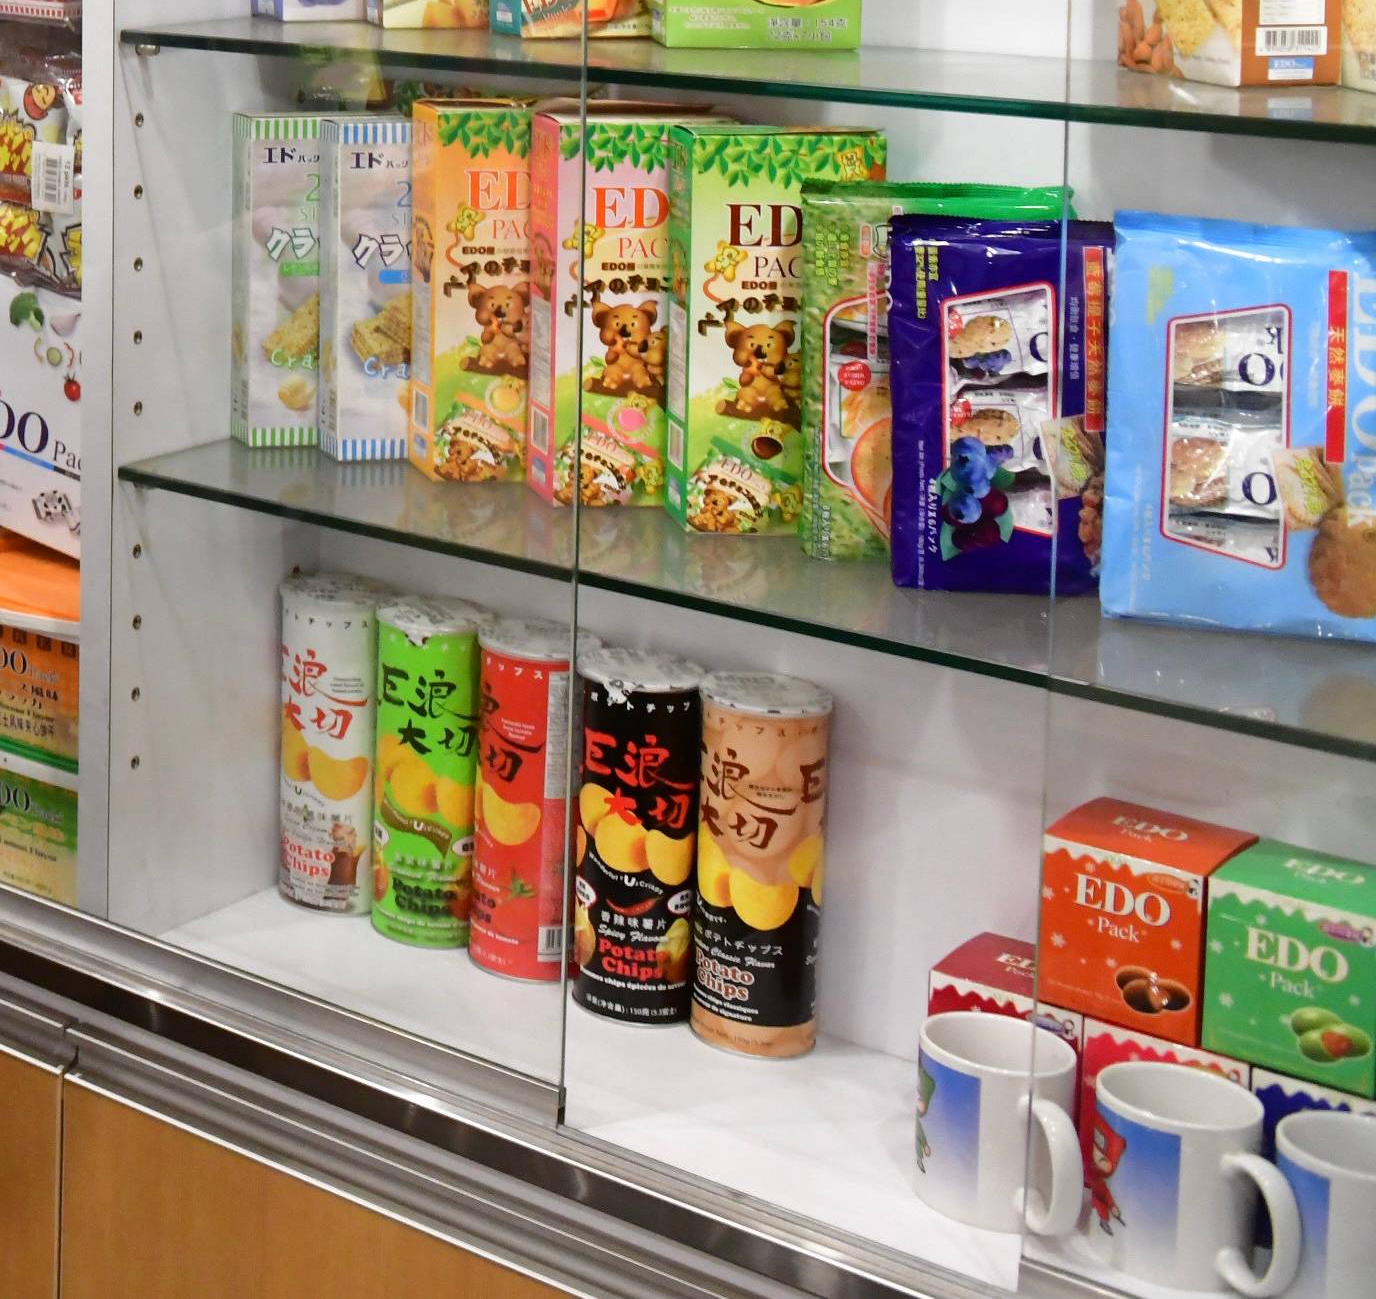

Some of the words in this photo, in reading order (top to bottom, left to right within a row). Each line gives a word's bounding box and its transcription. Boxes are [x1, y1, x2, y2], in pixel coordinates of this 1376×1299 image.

[466, 170, 531, 212] ED
[592, 185, 670, 230] ED
[726, 203, 803, 248] ED
[617, 236, 669, 258] PAC
[363, 357, 409, 379] Cra
[52, 440, 83, 473] Pac
[719, 457, 754, 480] EDO
[376, 663, 480, 721] 巨浪
[284, 697, 354, 739] 大切
[397, 719, 474, 757] 大切
[582, 727, 695, 792] 巨浪
[603, 787, 692, 830] 大切
[699, 800, 780, 851] 大切
[1111, 813, 1190, 842] EDO
[282, 836, 336, 863] Potato
[284, 854, 331, 877] Chips
[1285, 857, 1366, 886] EDO
[1072, 871, 1172, 928] EDO
[600, 909, 668, 931] 香辣味薯片
[1096, 916, 1141, 943] Pack
[598, 937, 667, 962] Potato
[1246, 925, 1350, 983] EDO
[601, 956, 663, 983] Chips
[696, 948, 755, 986] Potato
[697, 966, 749, 1002] Chips
[1269, 971, 1316, 999] Pack
